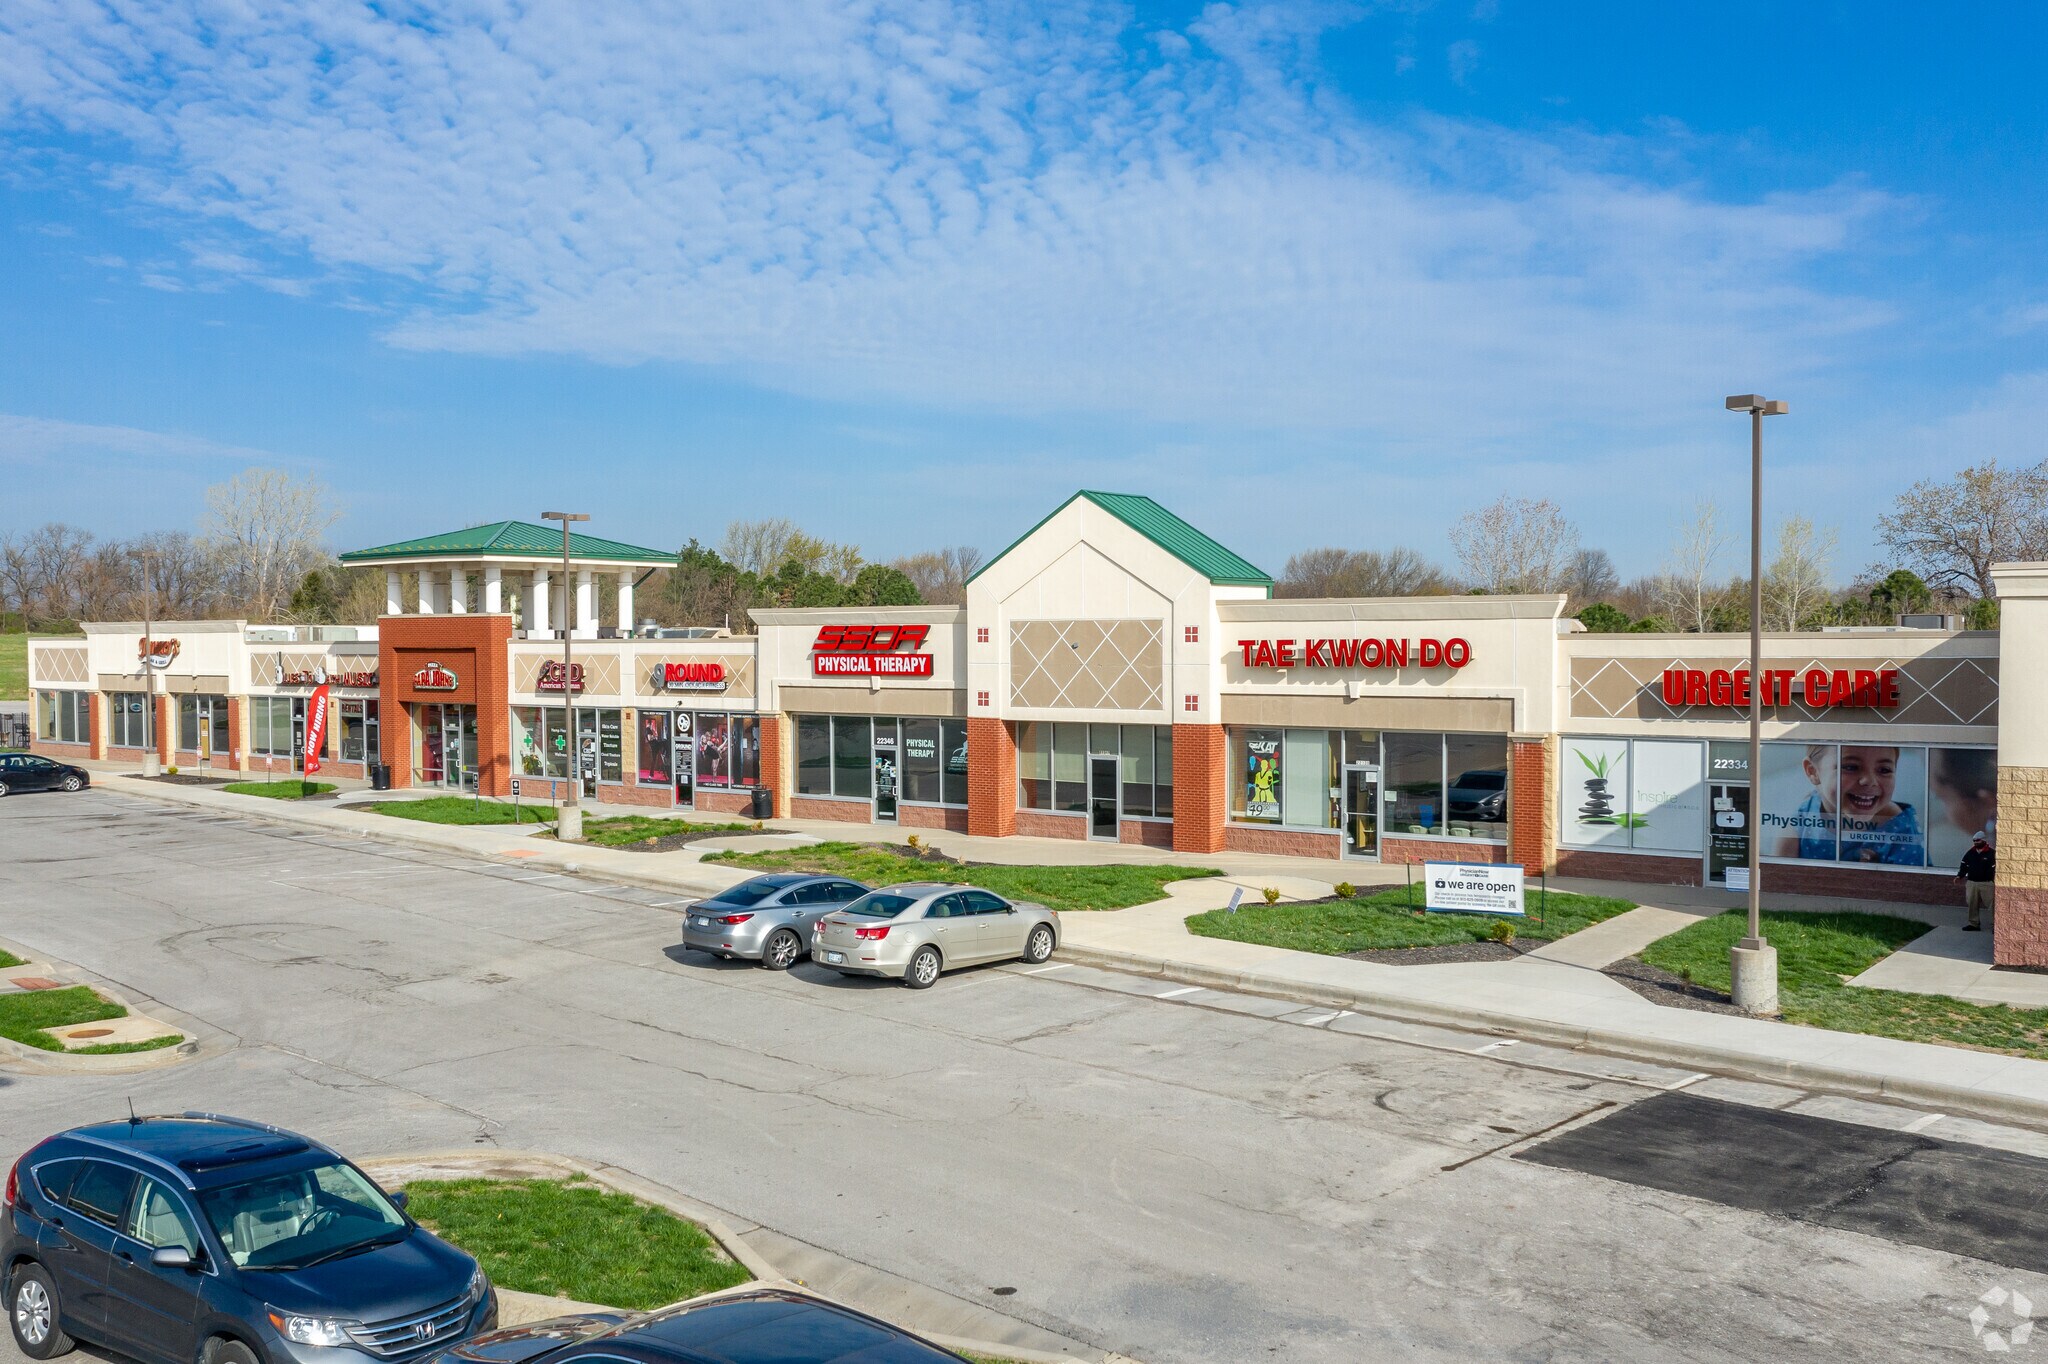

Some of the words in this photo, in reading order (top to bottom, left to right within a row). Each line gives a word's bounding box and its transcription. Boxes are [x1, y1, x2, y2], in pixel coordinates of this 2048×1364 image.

[812, 625, 931, 650] SSOR
[1237, 639, 1296, 668] TAE
[1305, 638, 1410, 669] KWON
[1419, 638, 1473, 669] DO
[818, 657, 871, 672] PHYSICAL
[874, 657, 927, 672] THERAPY
[1663, 669, 1796, 707] URGENT
[1804, 669, 1899, 707] CARE
[307, 731, 318, 756] NOW
[313, 695, 326, 733] HIRING
[906, 739, 935, 748] PHYSICAL
[907, 748, 935, 758] THERAPY
[1714, 759, 1748, 769] 22334
[1761, 813, 1835, 829] Physician
[1842, 817, 1878, 831] Now
[1850, 833, 1886, 841] URGENT
[1890, 834, 1914, 843] CARE
[1448, 880, 1464, 889] we
[1466, 881, 1484, 891] are
[1486, 883, 1516, 893] open
